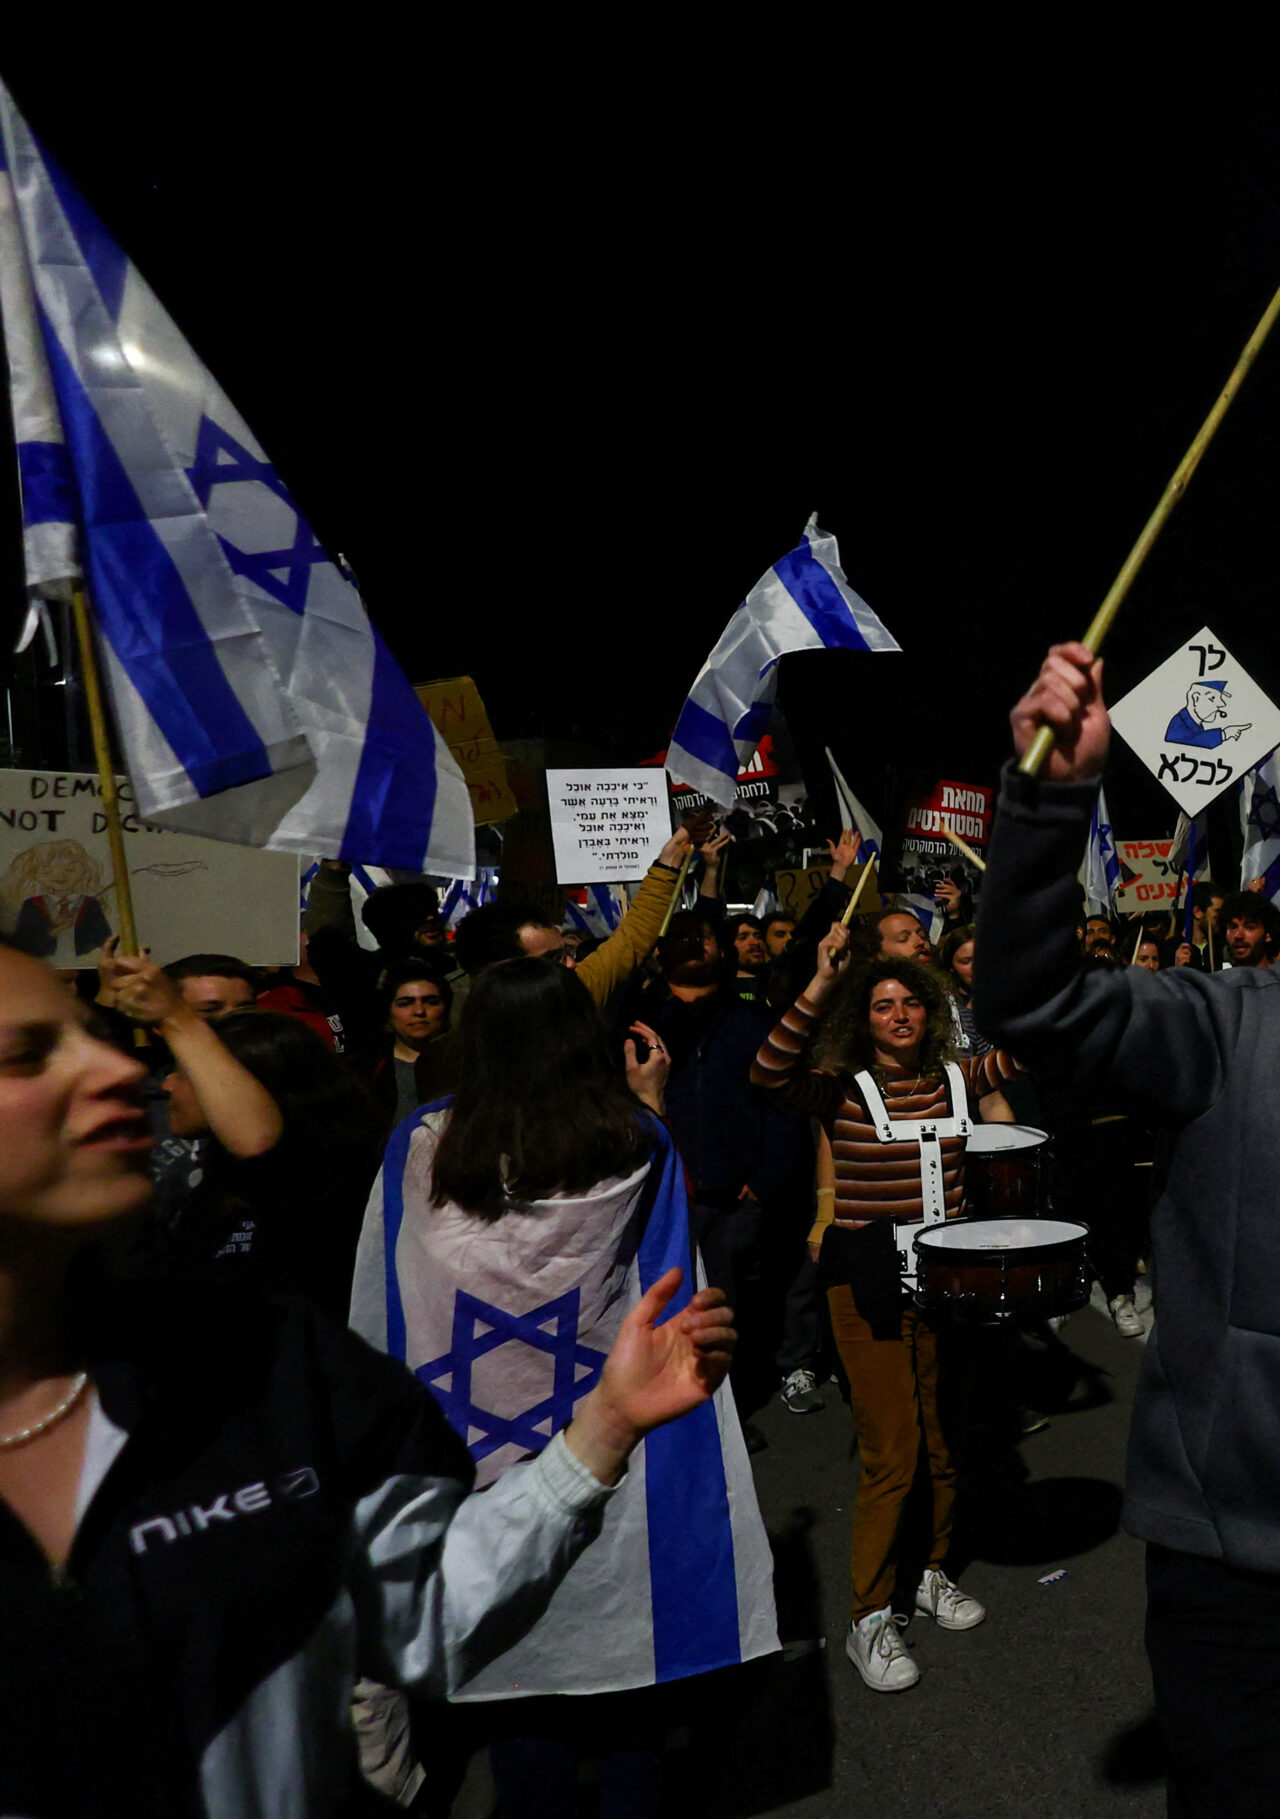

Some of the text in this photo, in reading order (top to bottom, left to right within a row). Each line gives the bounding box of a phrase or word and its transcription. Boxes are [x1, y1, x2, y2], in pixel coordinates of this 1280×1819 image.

[1189, 644, 1226, 676] לך
[1158, 753, 1232, 785] לכלא
[566, 783, 591, 791] אוכל
[597, 783, 628, 791] איככה
[561, 798, 585, 807] אשר
[624, 797, 657, 807] וראיתי
[941, 787, 985, 814] מחאת
[601, 812, 616, 820] את
[622, 811, 648, 820] ימצא
[579, 823, 645, 833] ואיככה אוכל
[907, 808, 983, 839] הסטודנטים
[616, 837, 649, 847] וראיתי
[903, 838, 946, 855] הדמוקרטיה
[129, 1481, 273, 1555] NIKE
